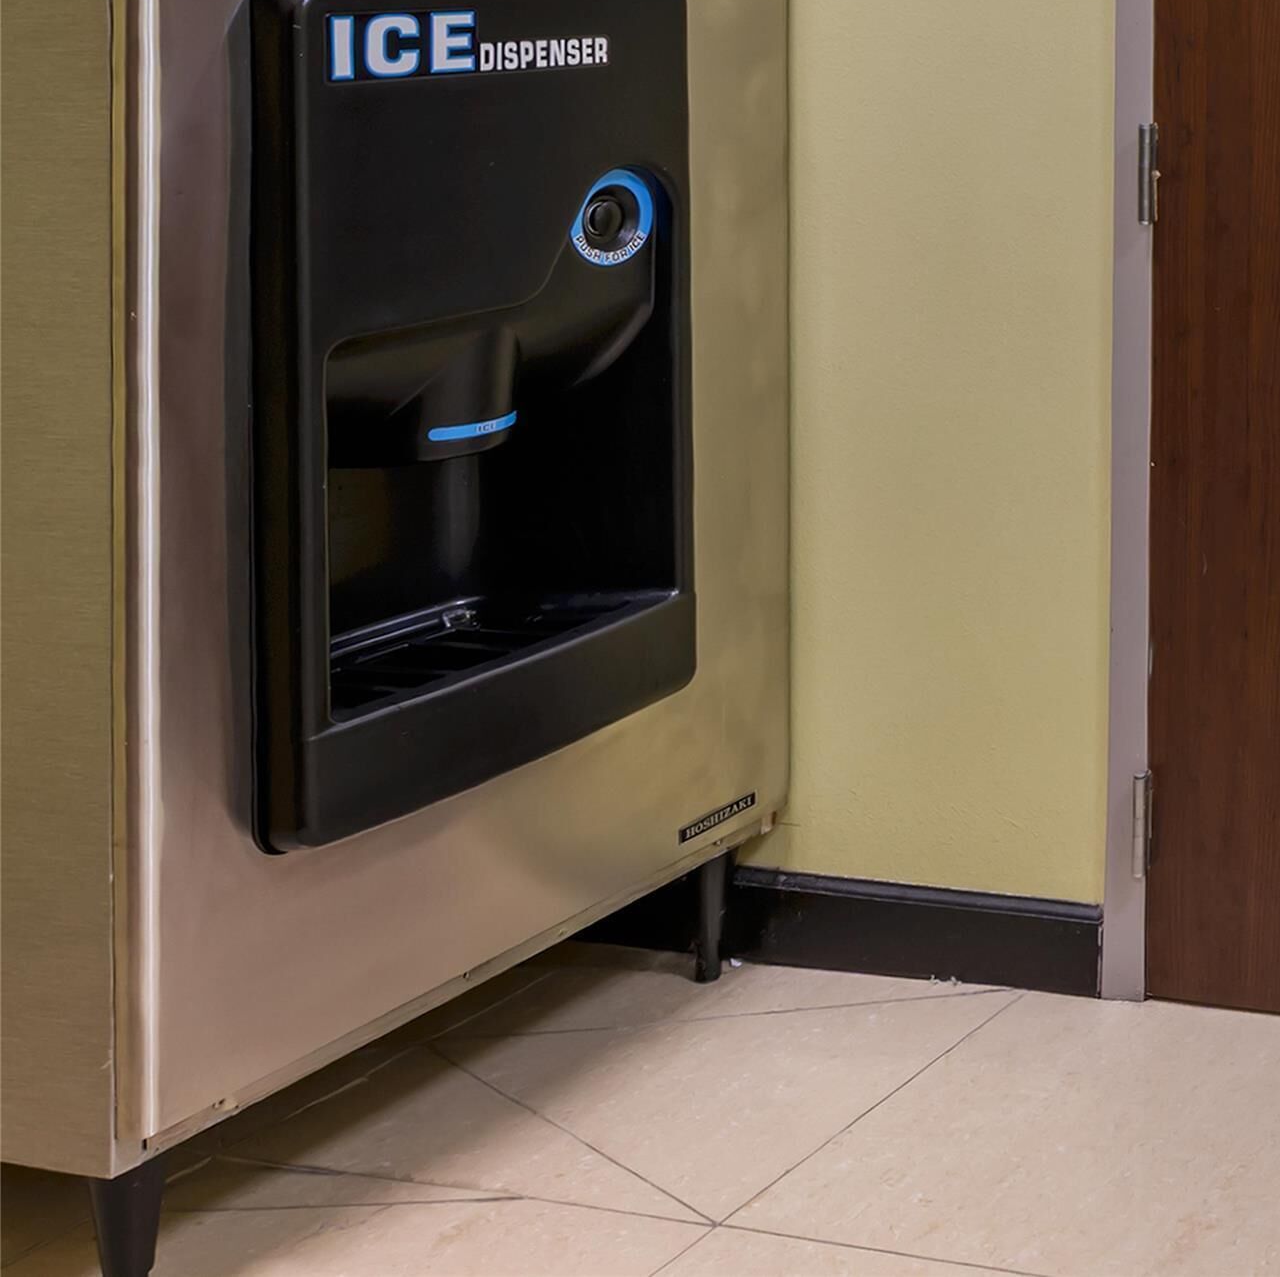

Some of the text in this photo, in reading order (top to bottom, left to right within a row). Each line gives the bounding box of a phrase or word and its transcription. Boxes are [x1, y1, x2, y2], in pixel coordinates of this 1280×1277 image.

[330, 10, 608, 81] ICE DISPENSER
[575, 232, 645, 262] PUSH FOR ICE
[685, 796, 752, 839] HOSHIZAKI
